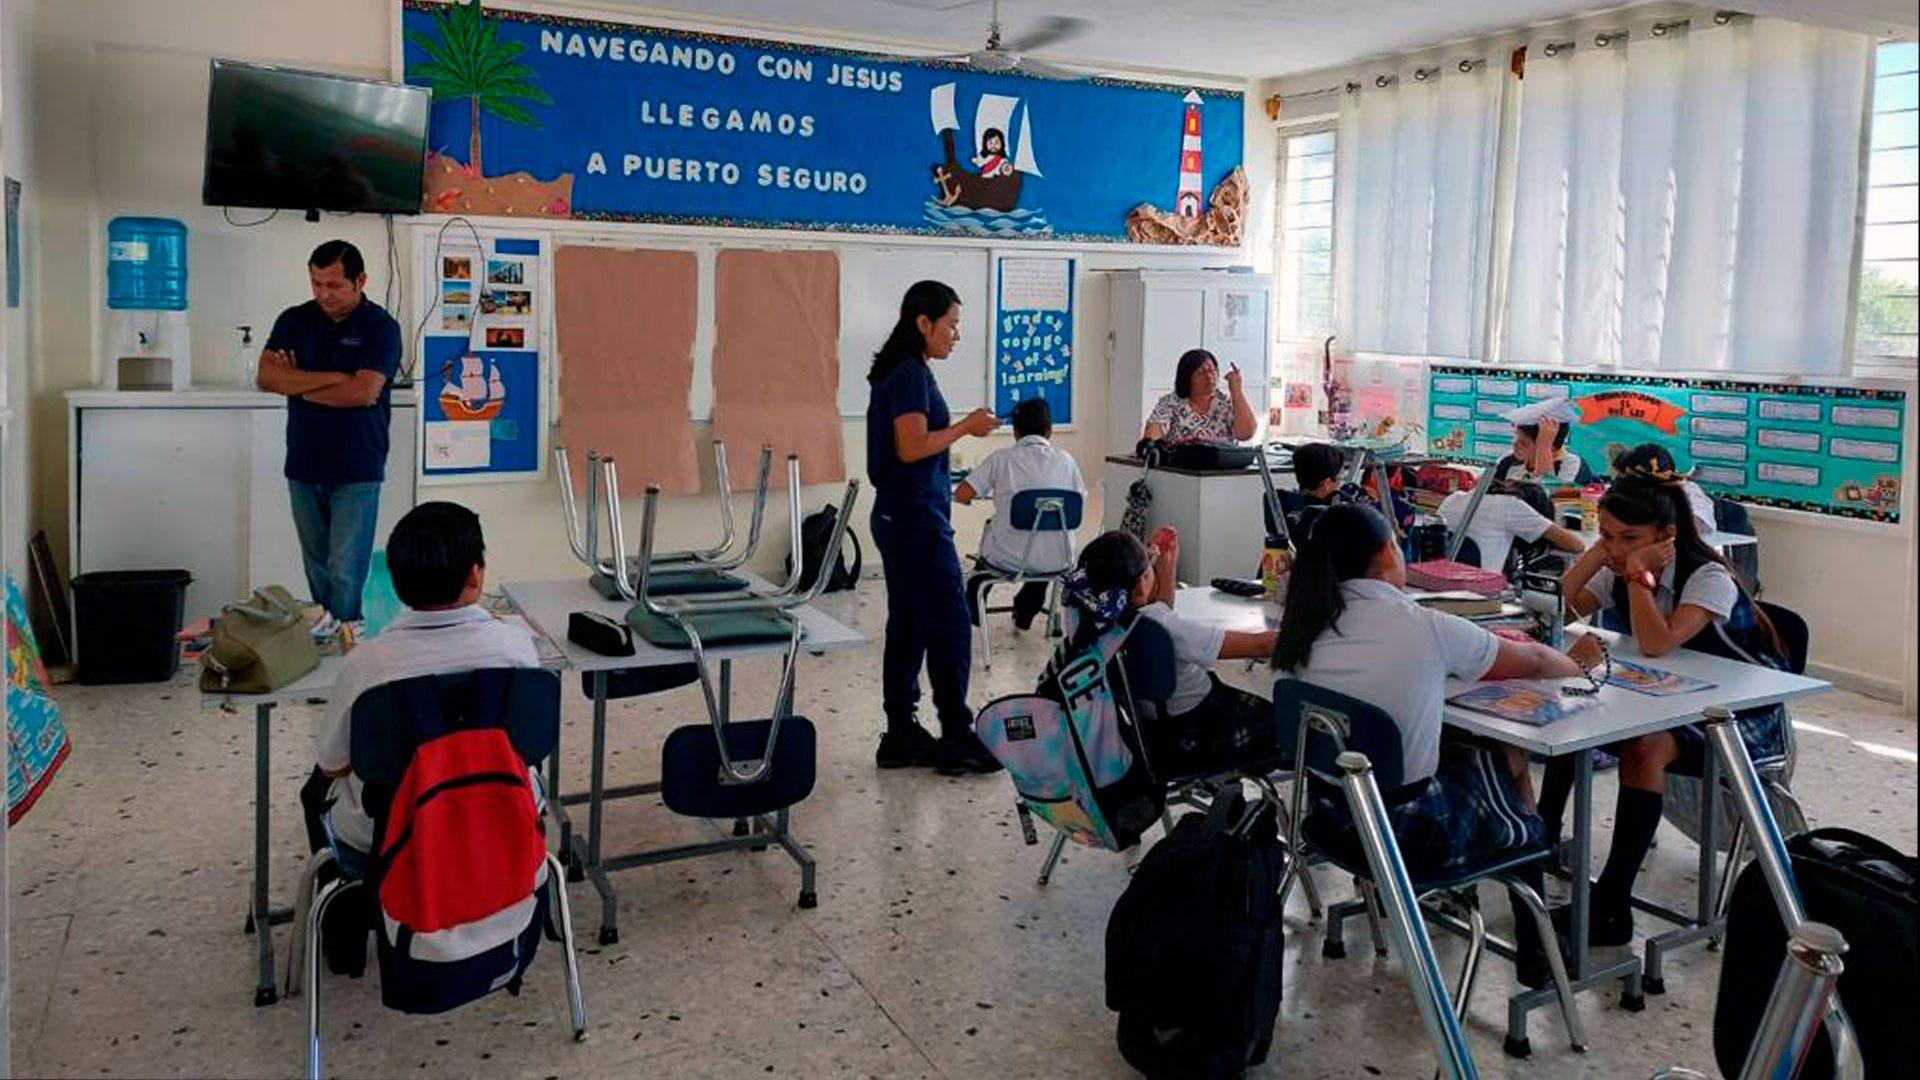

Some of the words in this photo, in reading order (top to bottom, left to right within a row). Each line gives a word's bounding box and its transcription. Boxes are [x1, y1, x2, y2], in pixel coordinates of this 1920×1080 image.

[540, 30, 736, 76] NAVEGANDO
[757, 55, 813, 83] CON
[827, 63, 904, 92] JESUS
[641, 101, 816, 138] LLEGAMOS
[586, 152, 607, 176] A
[623, 154, 740, 187] PUERTO
[757, 164, 867, 195] SEGURO
[1002, 333, 1062, 351] voyage
[1024, 351, 1040, 366] of
